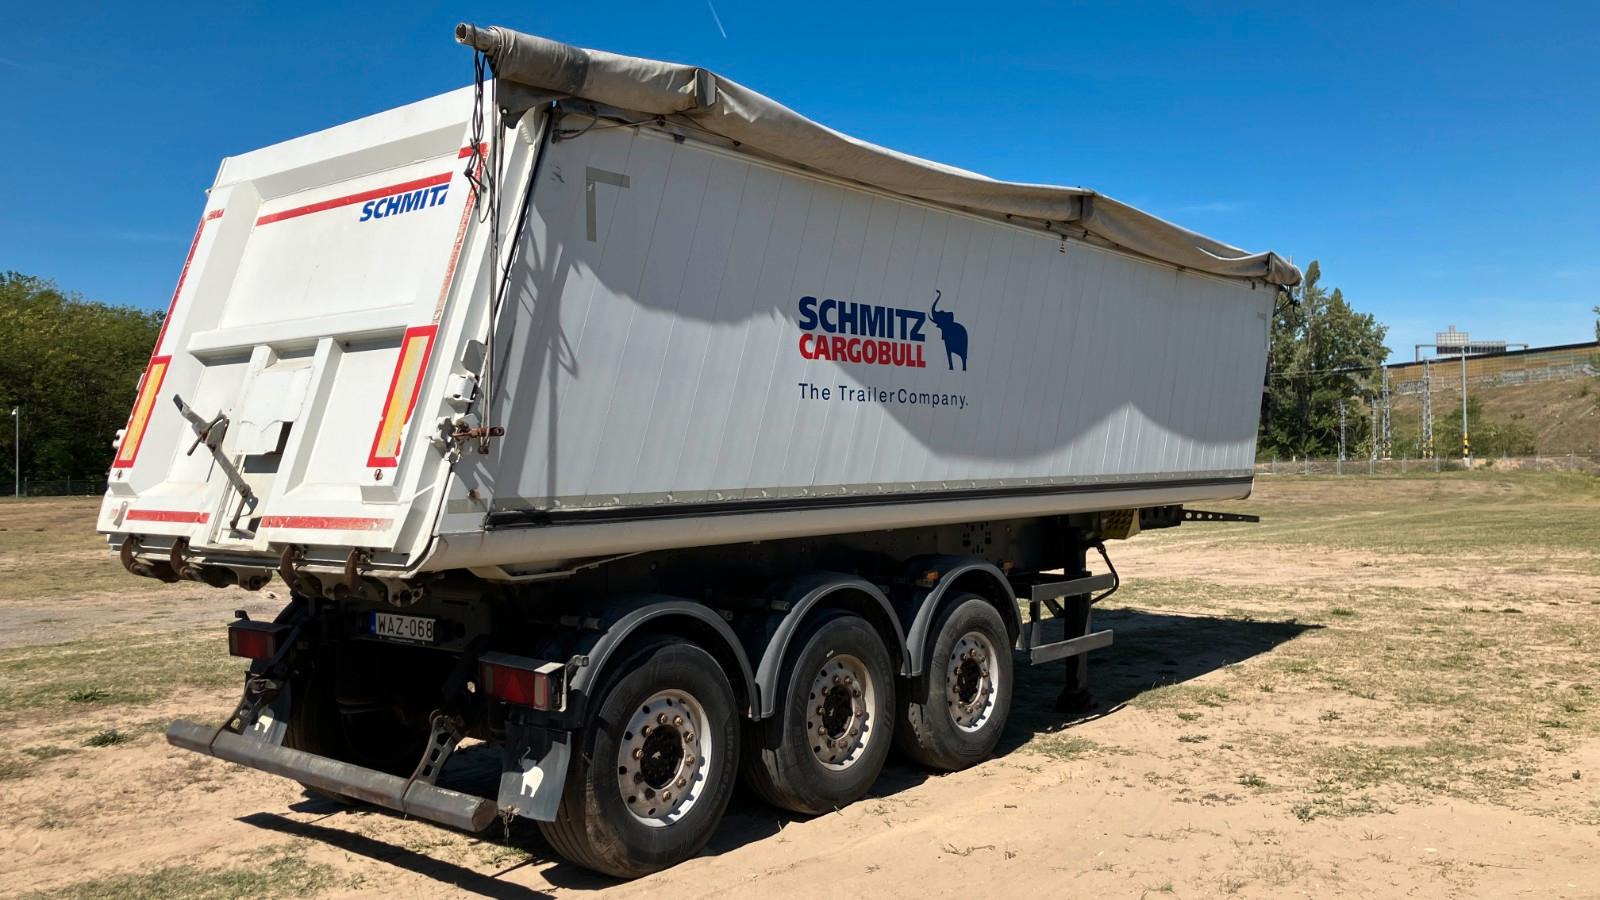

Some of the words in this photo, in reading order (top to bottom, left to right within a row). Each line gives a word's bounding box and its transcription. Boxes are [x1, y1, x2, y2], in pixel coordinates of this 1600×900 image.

[359, 183, 450, 222] SCHMITZ
[798, 296, 926, 342] SCHMITZ
[798, 333, 926, 368] CARGOBULL
[798, 383, 831, 400] The
[378, 615, 433, 639] WAZ-068
